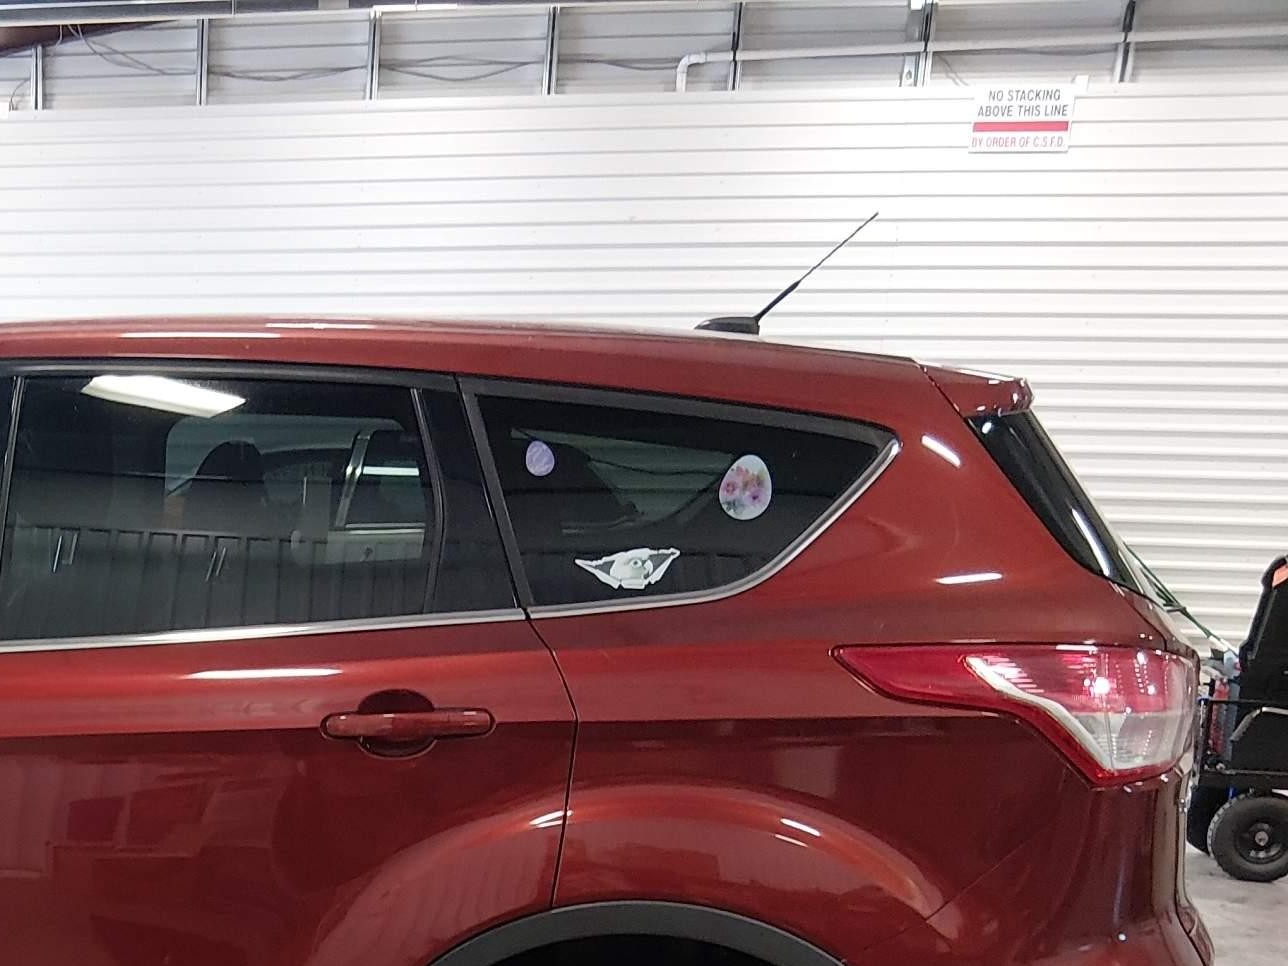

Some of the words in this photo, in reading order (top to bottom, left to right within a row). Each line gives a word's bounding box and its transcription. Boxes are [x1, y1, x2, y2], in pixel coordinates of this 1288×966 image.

[988, 90, 1003, 101] NO
[1008, 89, 1060, 101] STACKING
[978, 105, 1013, 117] ABOVE
[1017, 105, 1041, 117] THIS
[1044, 104, 1068, 117] LINE
[971, 136, 984, 148] BY
[986, 136, 1016, 147] ORDER
[1019, 136, 1031, 147] OF
